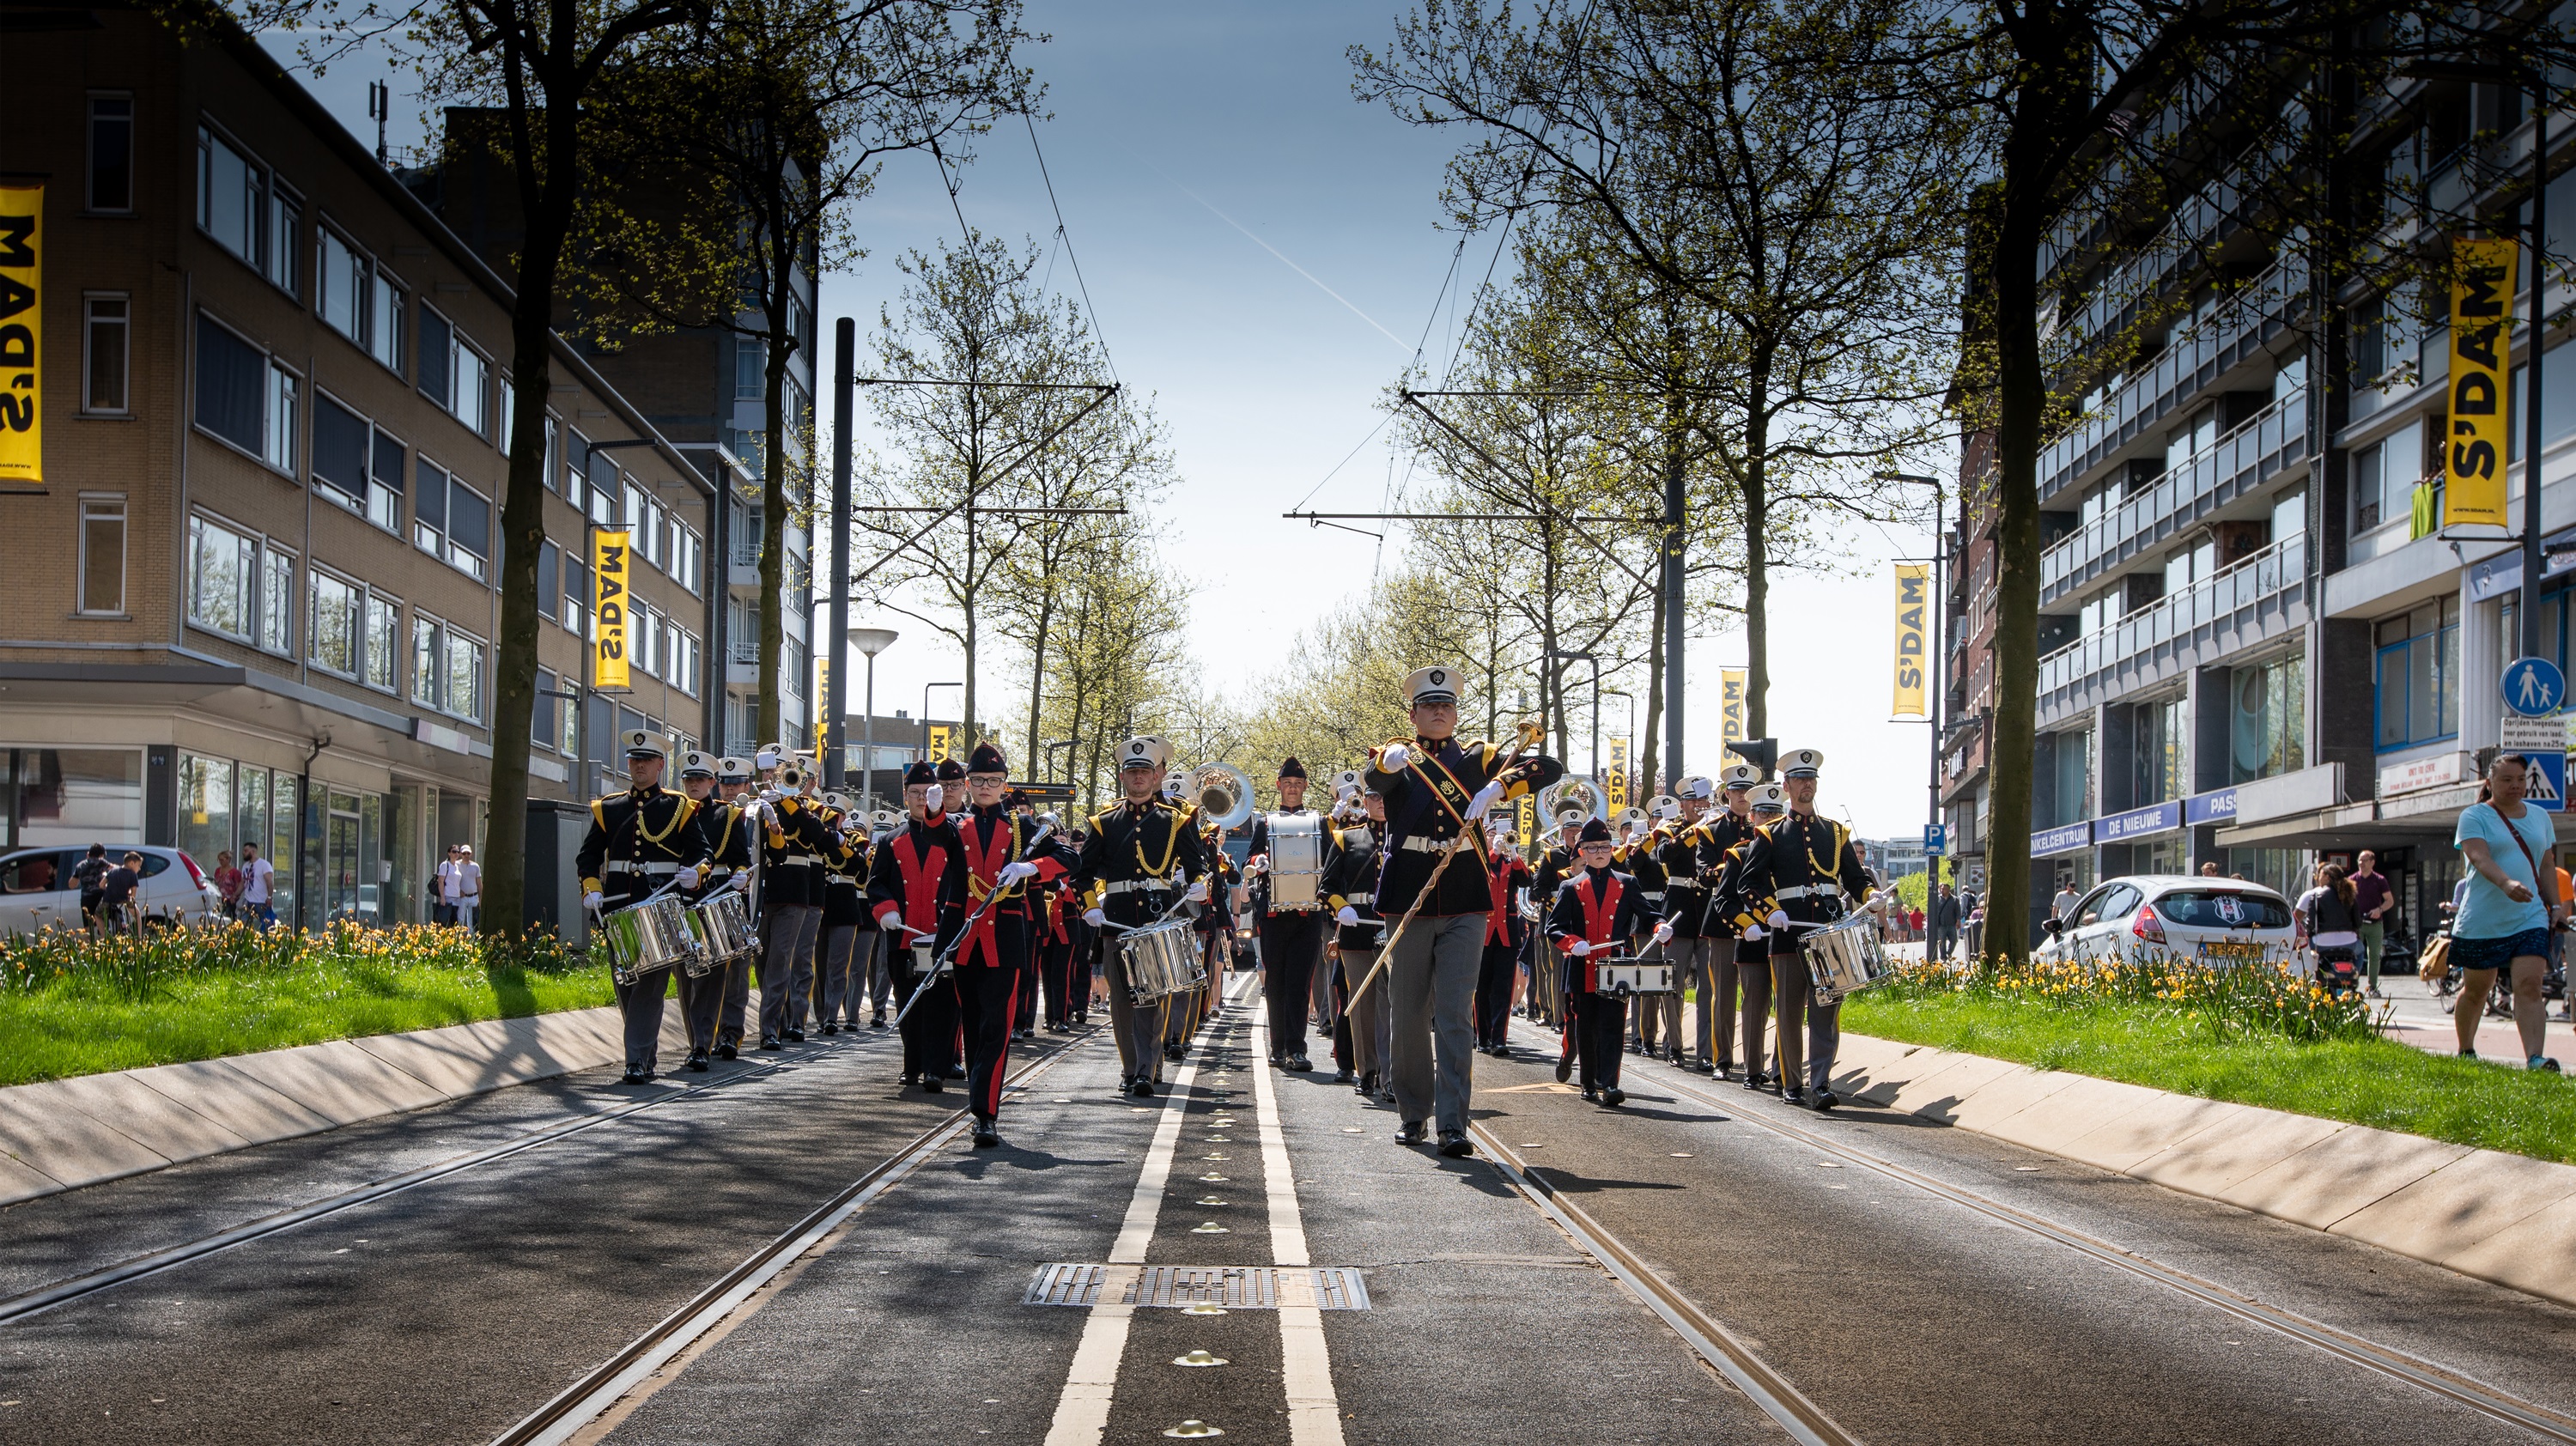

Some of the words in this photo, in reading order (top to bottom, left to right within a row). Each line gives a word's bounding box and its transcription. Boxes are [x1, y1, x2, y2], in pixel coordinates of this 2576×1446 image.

[2452, 263, 2507, 481] S'DAM
[1899, 577, 1923, 690] S'DAM
[2517, 730, 2537, 738] gebruik
[2531, 720, 2565, 729] toegestaan
[1612, 745, 1625, 805] S'DAM
[1929, 826, 1941, 843] P
[2109, 819, 2121, 835] DE
[2123, 810, 2162, 833] NIEUWE
[2031, 827, 2088, 852] NKELCENTRUM
